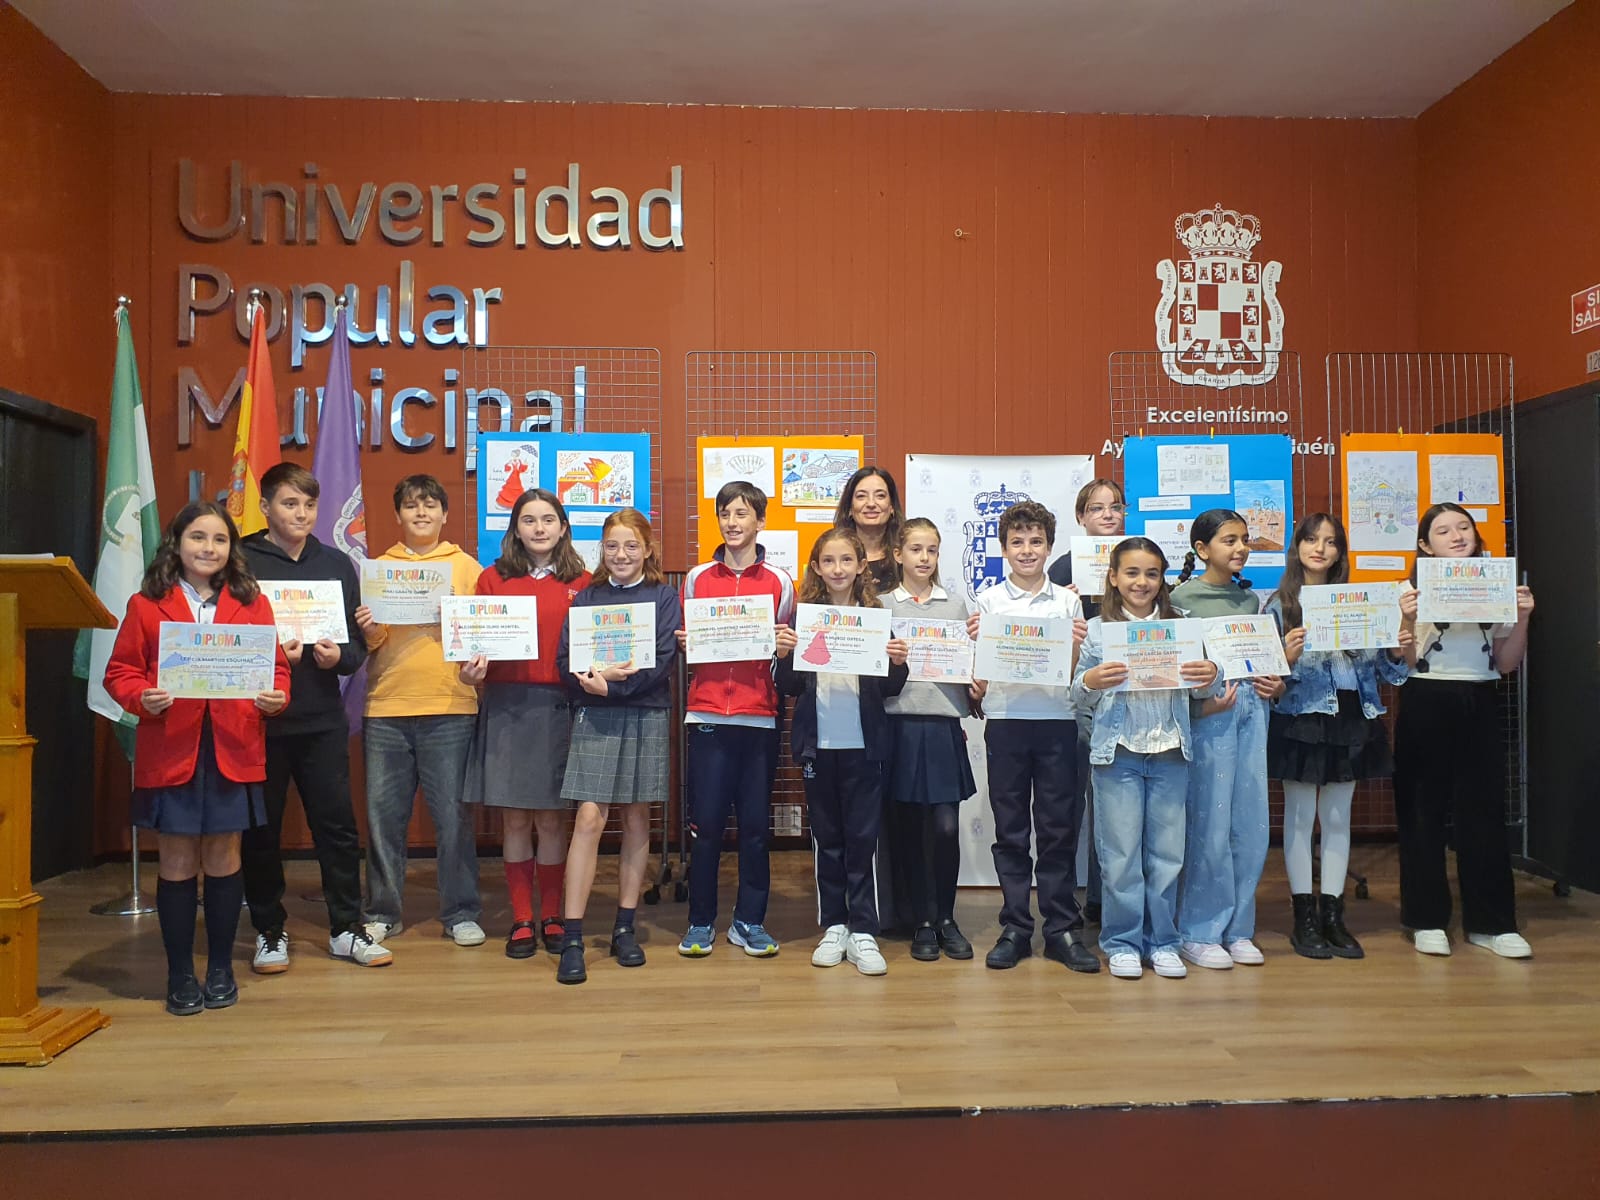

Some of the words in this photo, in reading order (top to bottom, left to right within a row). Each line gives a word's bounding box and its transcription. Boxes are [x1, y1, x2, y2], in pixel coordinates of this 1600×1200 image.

[177, 158, 684, 250] Universidad
[1587, 289, 1600, 307] SI
[177, 258, 503, 369] Popular
[1575, 307, 1600, 327] SAL
[1147, 407, 1289, 424] Excelentísimo
[387, 569, 425, 580] DIPLOMA
[1446, 566, 1486, 578] DIPLOMA
[274, 589, 314, 601] DIPLOMA
[1330, 591, 1369, 604] DIPLOMA
[469, 604, 508, 615] DIPLOMA
[710, 604, 747, 617] DIPLOMA
[595, 612, 631, 626] DIPLOMA
[824, 614, 862, 627] DIPLOMA
[911, 626, 947, 639] DIPLOMA
[1005, 624, 1044, 638] DIPLOMA
[1131, 628, 1172, 641] DIPLOMA
[1225, 623, 1257, 634] DIPLOMA
[194, 633, 241, 647] DIPLOMA
